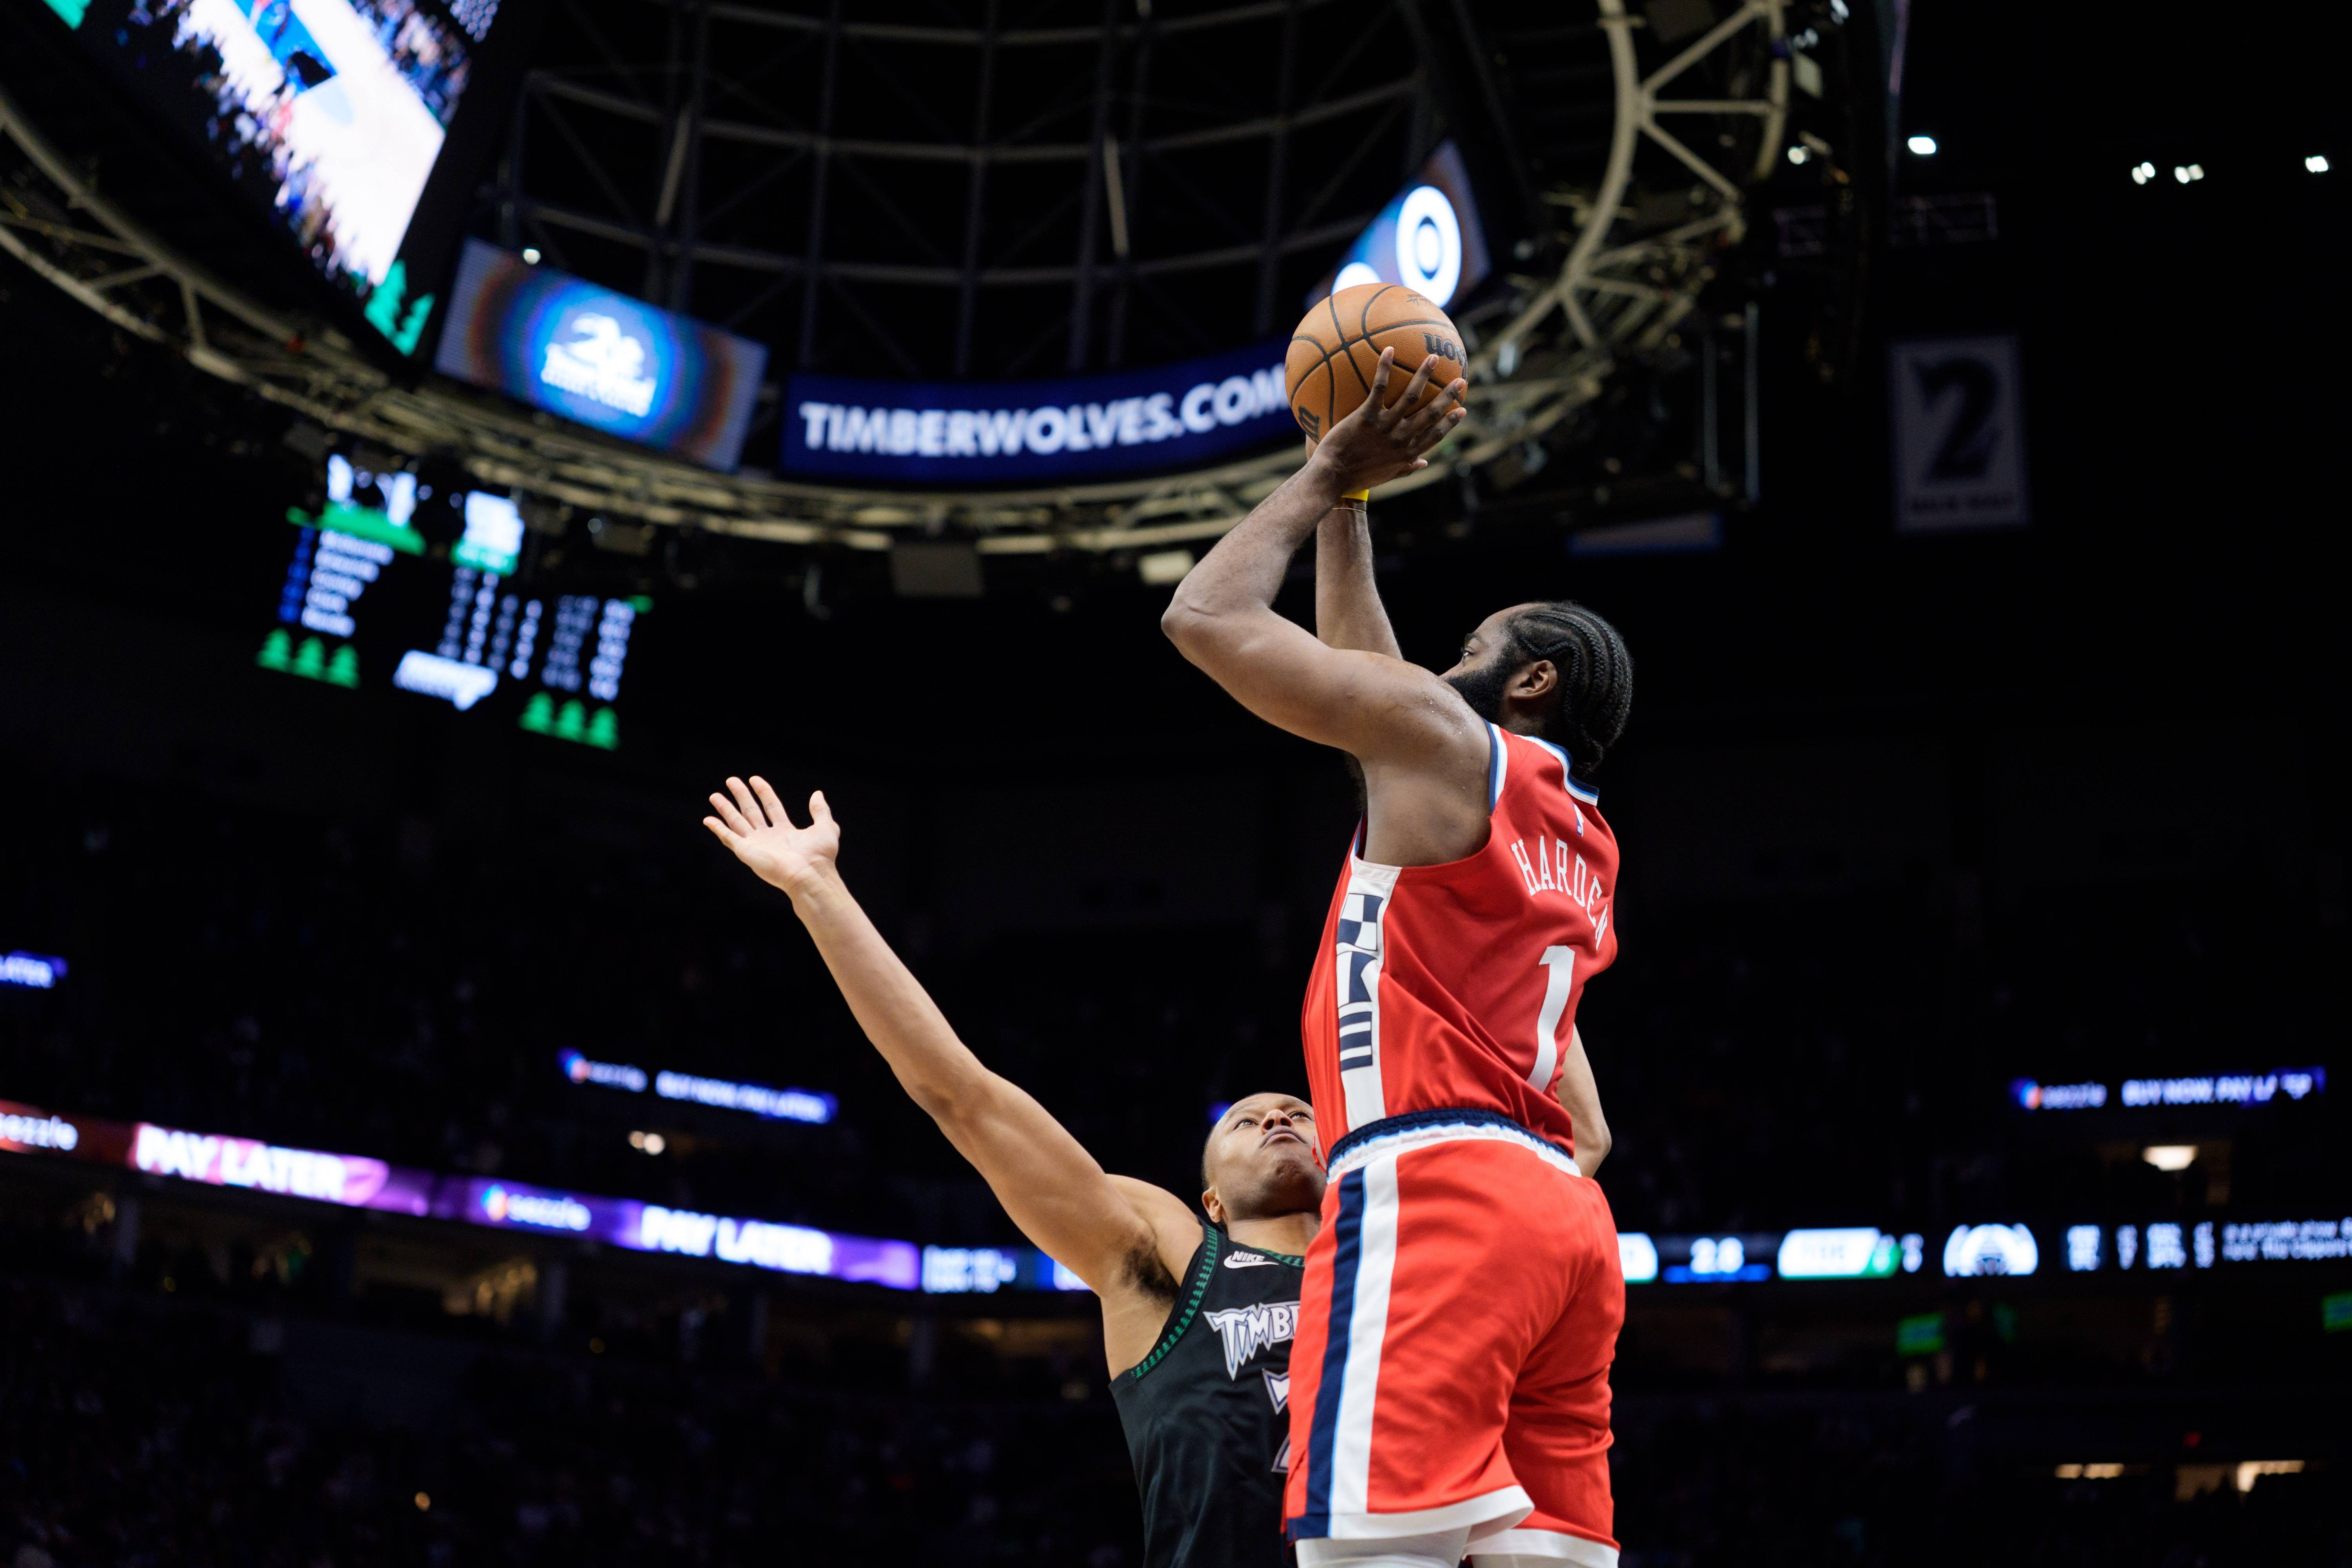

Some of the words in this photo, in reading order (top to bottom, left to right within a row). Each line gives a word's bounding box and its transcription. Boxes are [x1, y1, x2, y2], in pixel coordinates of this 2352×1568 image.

[1914, 358, 1999, 481] 2
[1511, 836, 1608, 951] HARDEN
[1526, 945, 1575, 1094] 1
[0, 1111, 78, 1151] ezzle
[136, 1125, 219, 1178] PAY
[221, 1138, 347, 1202] LATER
[641, 1205, 717, 1256] PAY
[715, 1217, 833, 1275] LATER
[1232, 1250, 1265, 1262] NIKE
